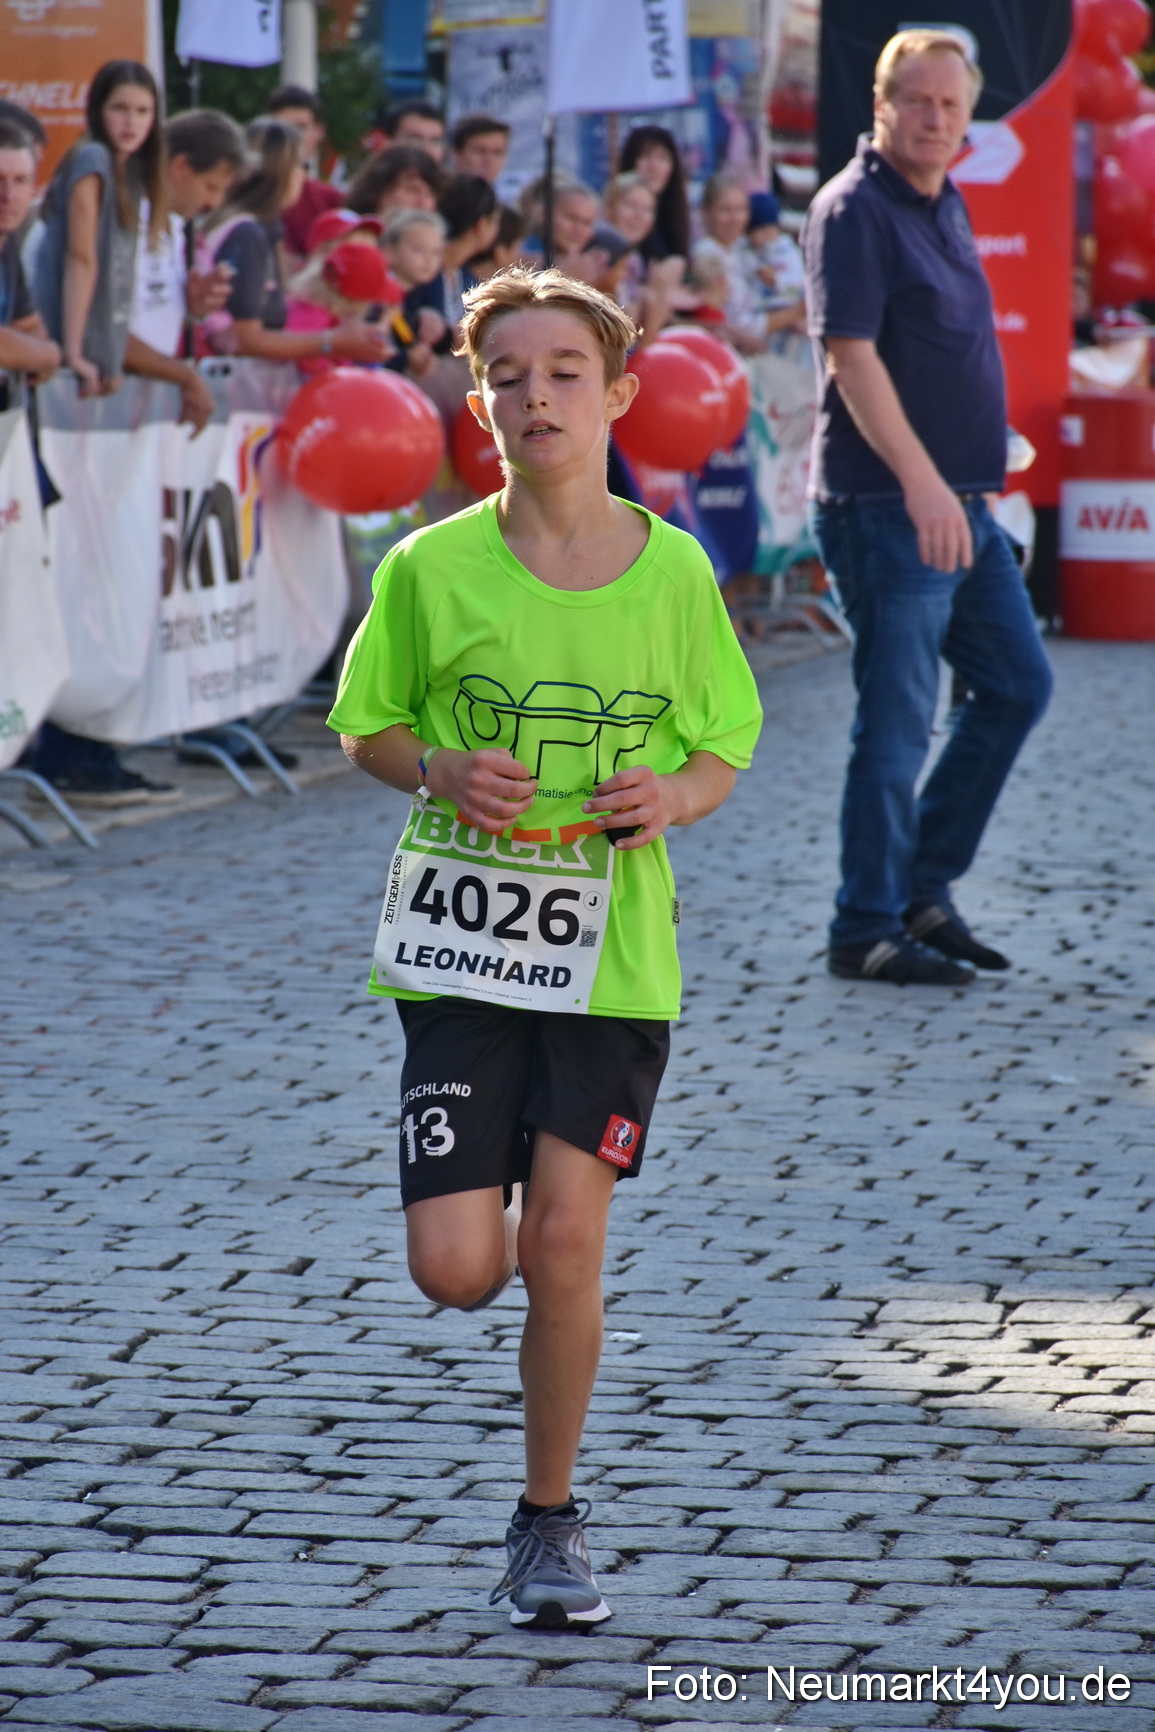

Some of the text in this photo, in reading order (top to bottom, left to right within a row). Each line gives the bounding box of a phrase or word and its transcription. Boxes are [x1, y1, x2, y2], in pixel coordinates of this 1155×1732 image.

[409, 867, 581, 946] 4026
[588, 896, 598, 907] J
[394, 942, 572, 989] LEONHARD
[400, 1106, 455, 1165] 13
